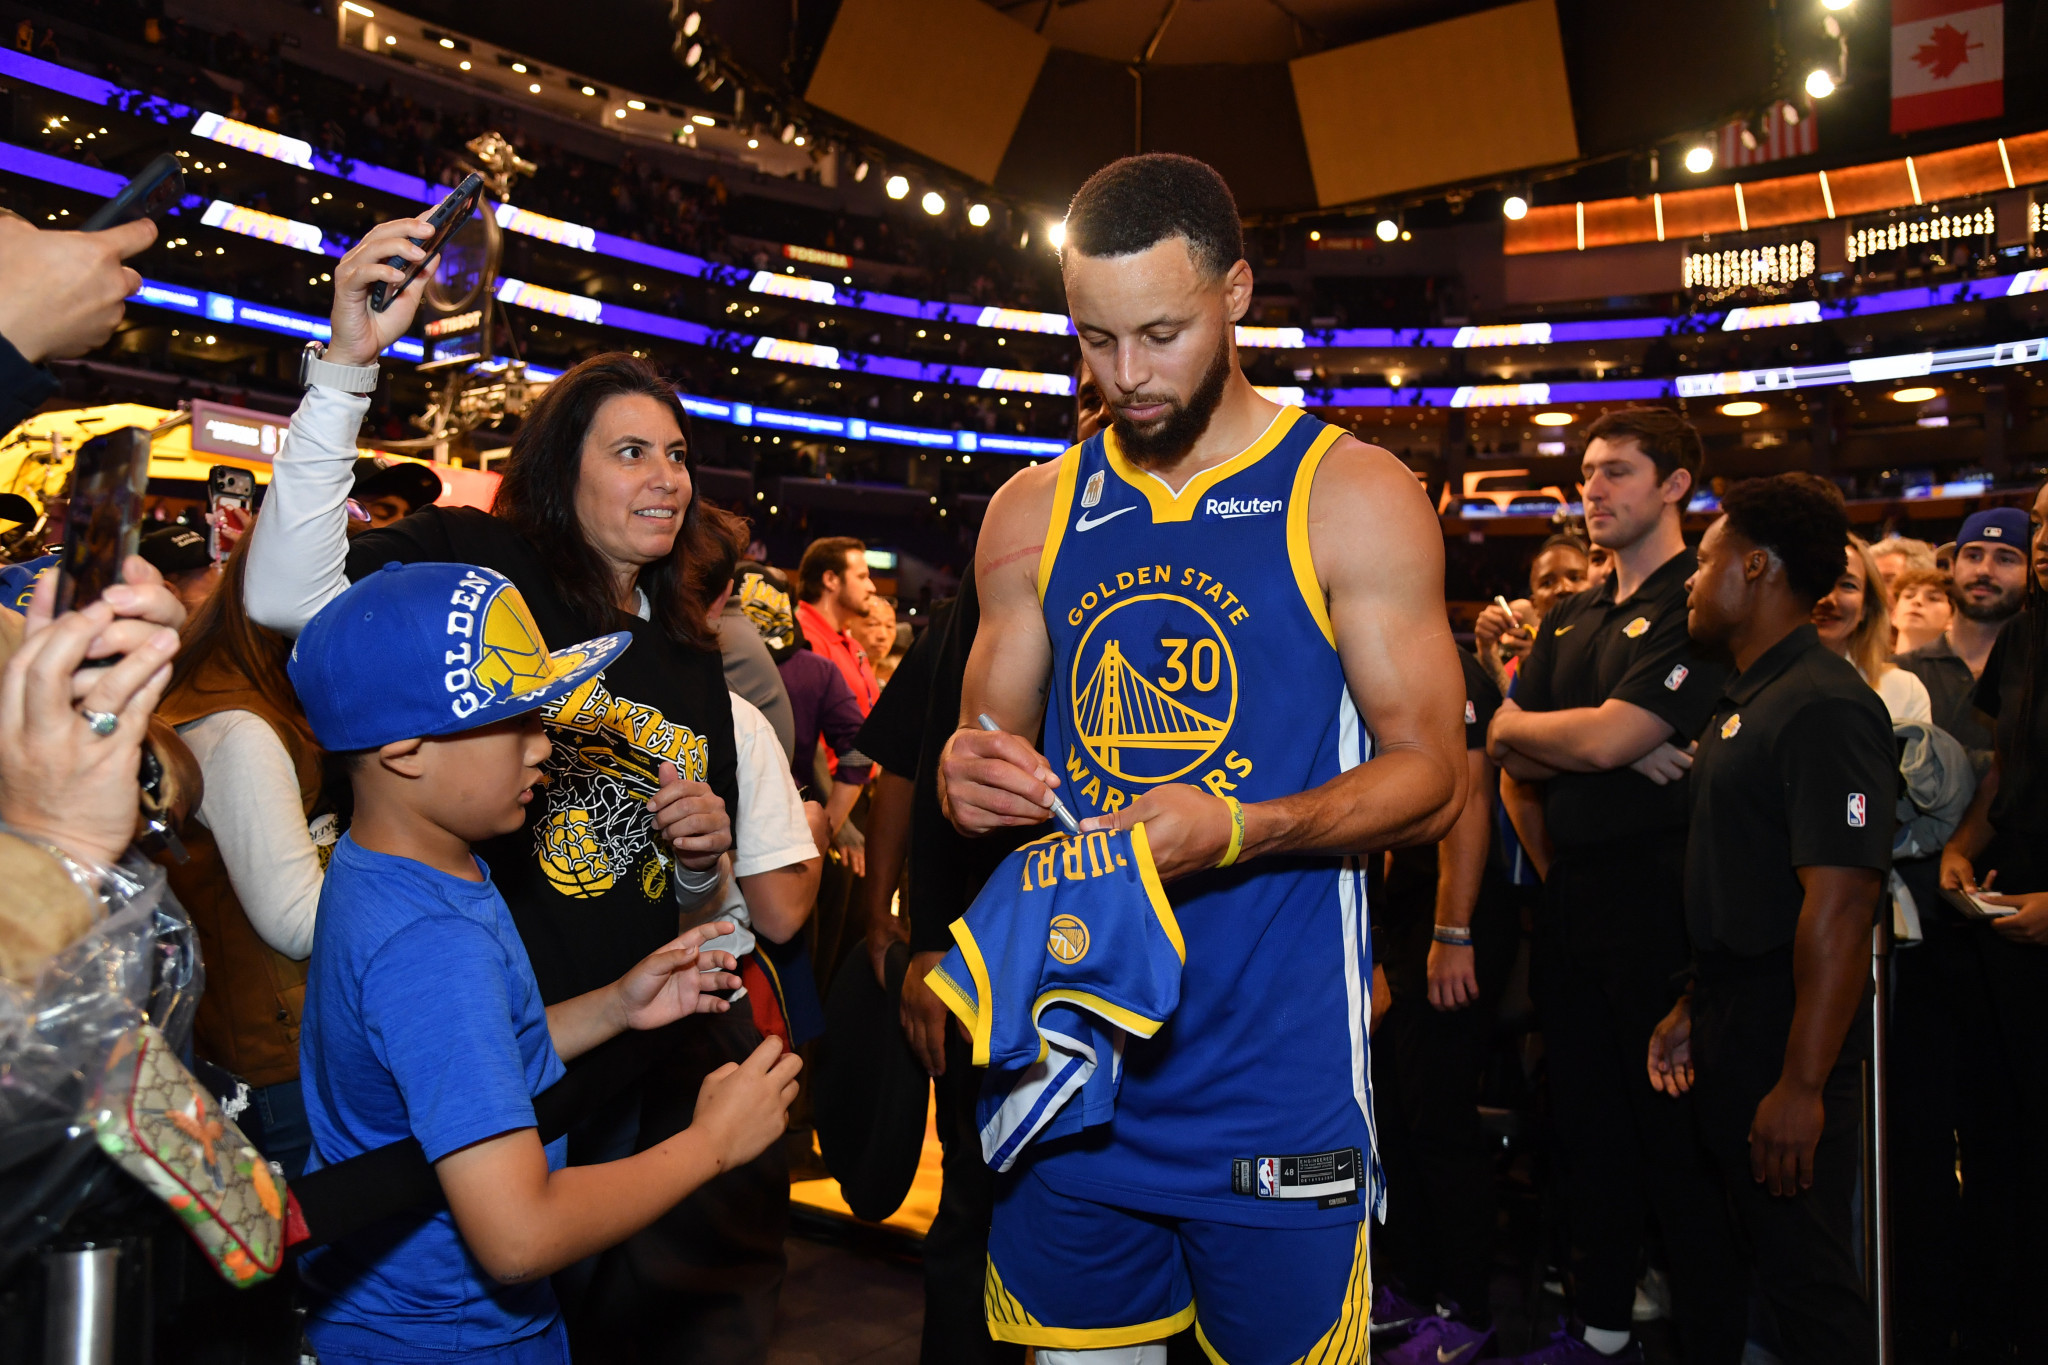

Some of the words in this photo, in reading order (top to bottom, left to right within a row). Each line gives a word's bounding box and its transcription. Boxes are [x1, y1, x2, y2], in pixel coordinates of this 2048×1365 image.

[1205, 497, 1283, 516] Rakuten
[1068, 565, 1171, 626] GOLDEN
[1180, 568, 1250, 626] STATE
[444, 571, 492, 719] GOLDEN
[1158, 638, 1220, 692] 30
[1066, 743, 1253, 814] WARRS
[1283, 1168, 1295, 1177] 48
